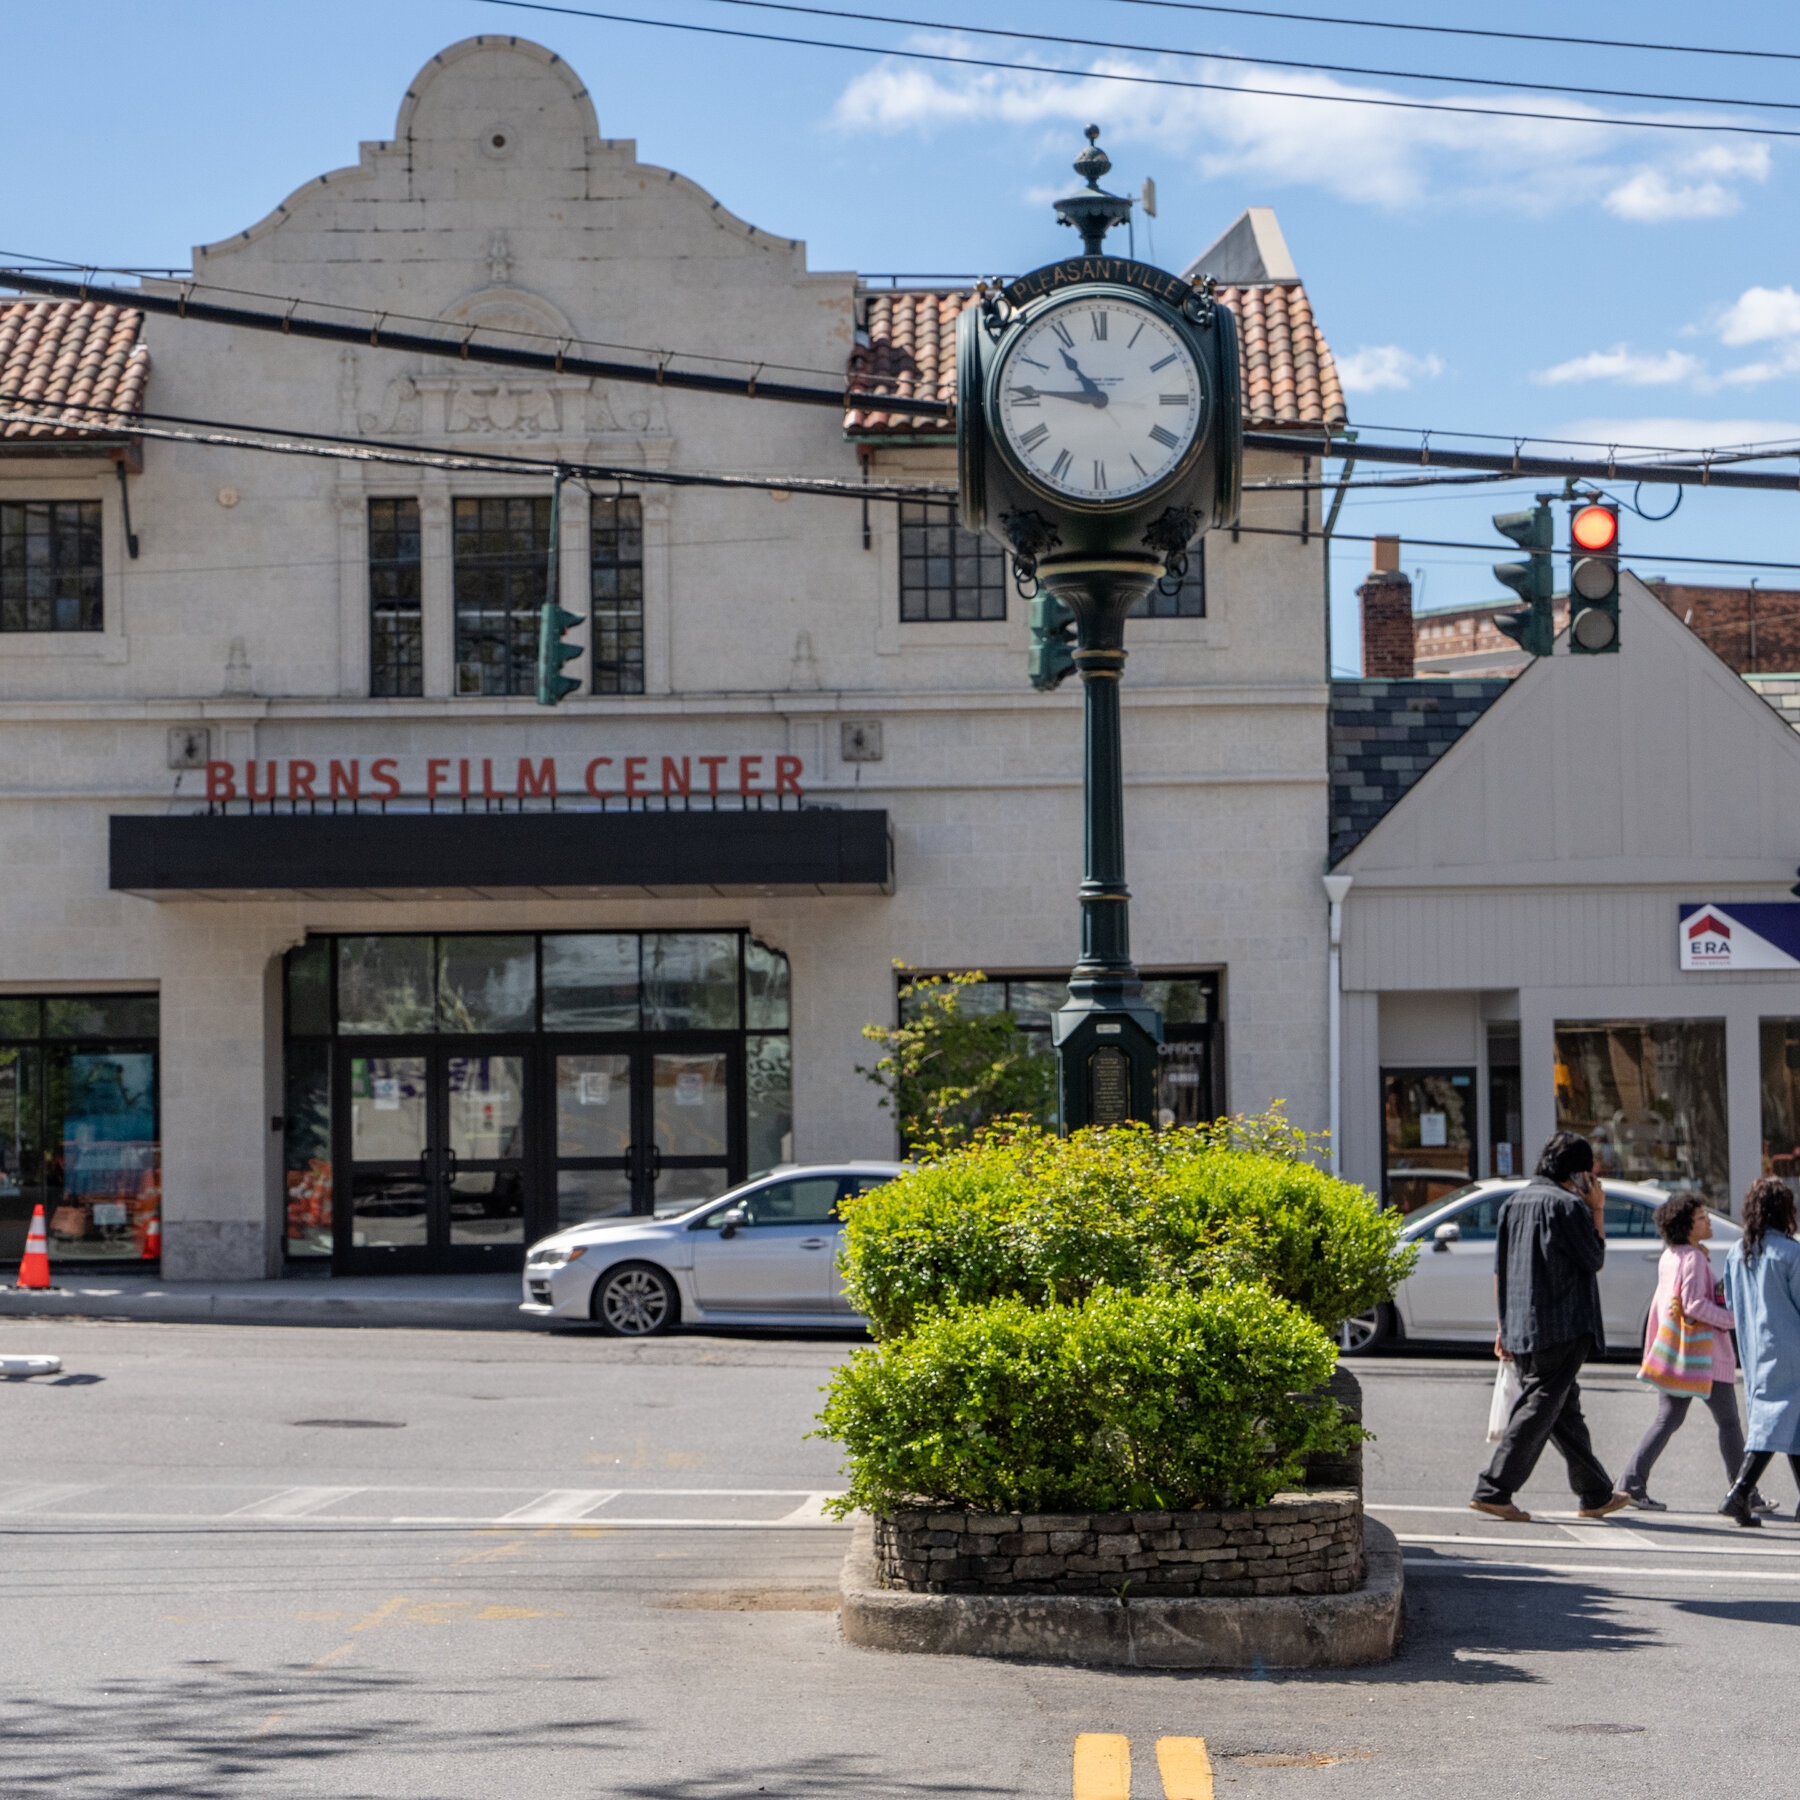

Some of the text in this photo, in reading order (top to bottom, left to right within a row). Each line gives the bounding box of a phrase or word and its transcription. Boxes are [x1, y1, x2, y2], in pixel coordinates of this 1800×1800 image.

[1012, 260, 1179, 300] PLEASANTVILLE
[206, 755, 804, 802] BURNS FILM CENTER
[1691, 942, 1731, 954] ERA
